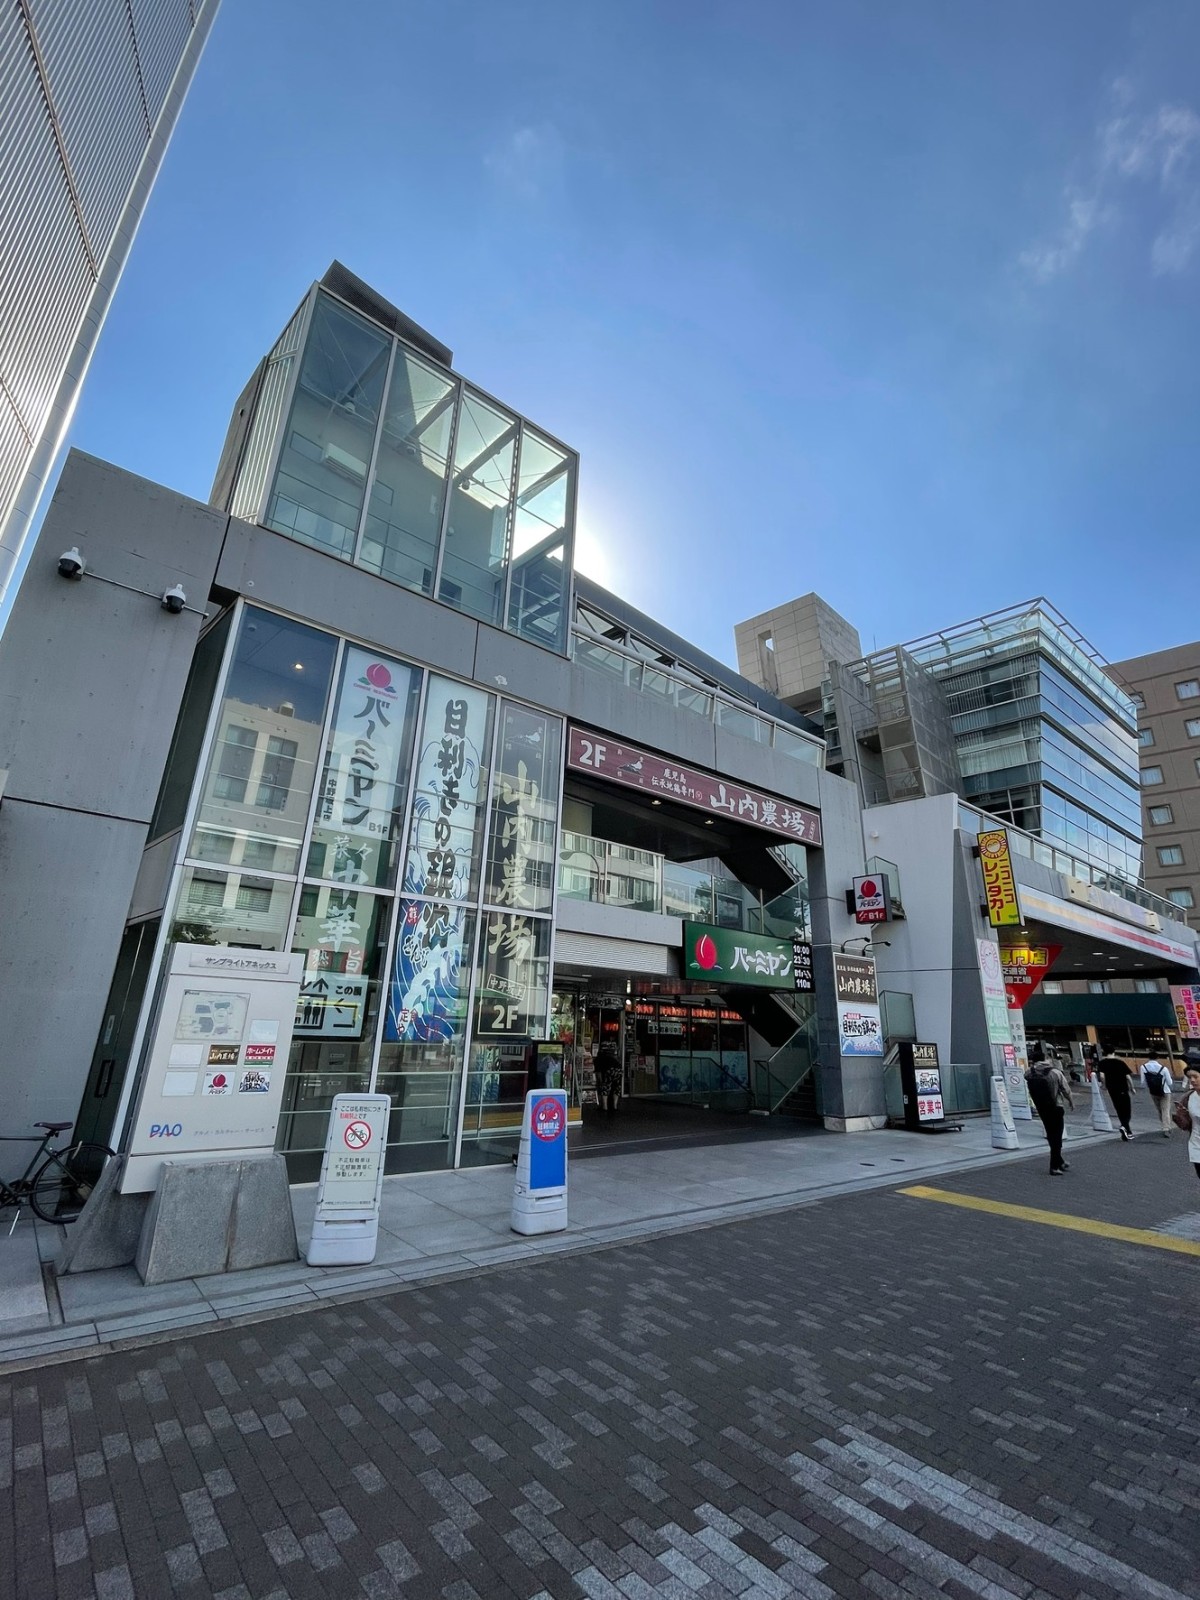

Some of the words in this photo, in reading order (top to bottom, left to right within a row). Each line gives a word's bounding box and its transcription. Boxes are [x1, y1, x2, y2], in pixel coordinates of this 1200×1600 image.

[343, 696, 390, 826] バーミヤン
[580, 739, 607, 768] 2F
[663, 767, 687, 784] 鹿児島
[709, 783, 805, 836] 山内農場
[368, 821, 388, 834] B1F
[487, 760, 539, 966] 山内農場
[984, 862, 1004, 922] レンタカー
[999, 858, 1014, 904] ニコニコ
[868, 911, 884, 920] B1F
[793, 944, 809, 955] 10:00
[793, 955, 810, 966] 23:30
[730, 946, 792, 977] バーミヤン
[838, 975, 871, 996] 山内農場
[491, 1004, 519, 1029] 2F
[918, 1100, 942, 1116] 営業中
[150, 1123, 182, 1138] PAO
